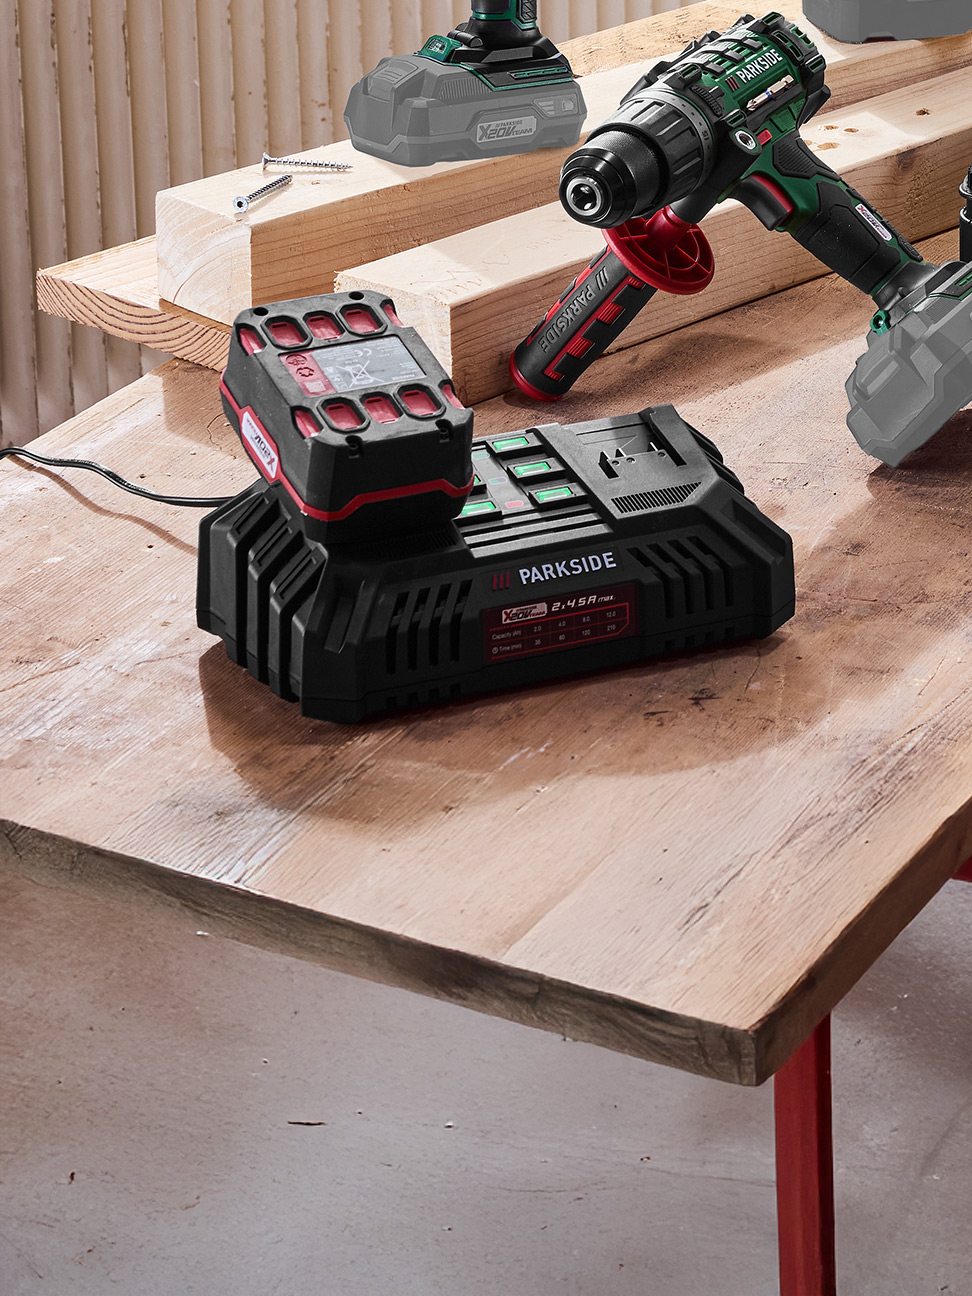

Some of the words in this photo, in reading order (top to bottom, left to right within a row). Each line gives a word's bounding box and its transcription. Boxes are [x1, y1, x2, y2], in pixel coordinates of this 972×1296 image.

[735, 48, 783, 84] PARKSIDE
[537, 284, 597, 353] PARKSIDE
[518, 551, 617, 585] PARKSIDE
[491, 630, 512, 641] Capacity
[606, 610, 616, 618] 12.0
[499, 644, 510, 652] Time
